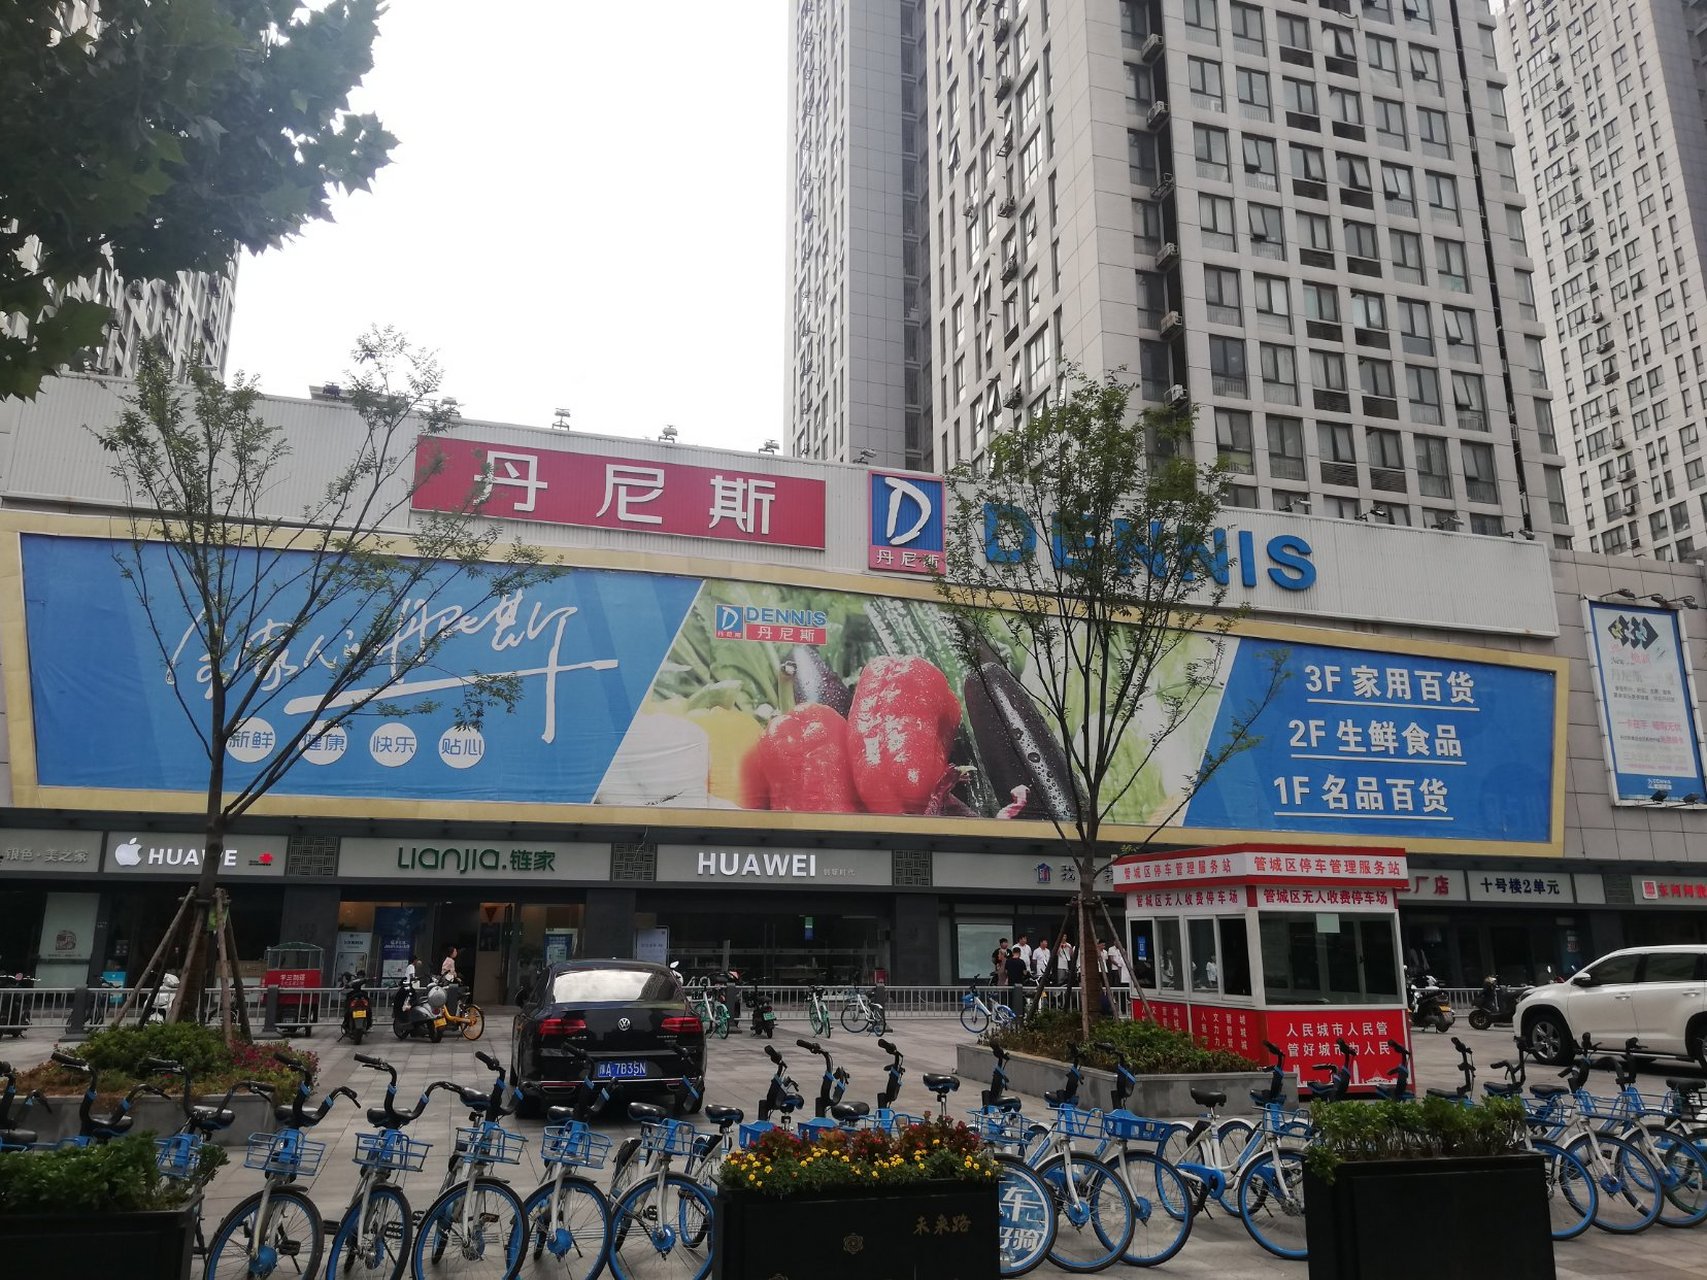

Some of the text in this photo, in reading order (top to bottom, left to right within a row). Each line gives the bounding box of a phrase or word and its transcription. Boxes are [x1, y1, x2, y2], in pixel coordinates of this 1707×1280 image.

[473, 449, 776, 535] 丹尼斯
[885, 476, 932, 546] D
[983, 502, 1317, 591] DENNIS
[876, 550, 940, 569] 丹尼斯
[745, 606, 828, 627] DENNIS
[758, 626, 815, 643] 丹尼斯
[1305, 664, 1476, 705] 3F 家用百货
[228, 730, 274, 748] 新鲜
[302, 733, 346, 752] 健康
[372, 735, 415, 753] 快乐
[1288, 718, 1464, 758] 2F 生鲜食品
[441, 740, 484, 758] 贴心
[1273, 773, 1449, 813] 1F 名品百货
[148, 848, 238, 867] HUAE
[697, 852, 817, 877] HUAWEI
[1253, 855, 1401, 877] 管城区停车管理服务站
[1124, 857, 1232, 881] 管城区停车管理服务站
[1396, 874, 1449, 896] 厂店
[1480, 876, 1561, 896] 十号楼2单元
[1136, 888, 1239, 908] 管城区无人收费停车场
[1263, 887, 1388, 906] 管城区无人收费停车场
[1286, 1021, 1388, 1037] 人民城市人民管
[912, 1213, 972, 1236] 未来路
